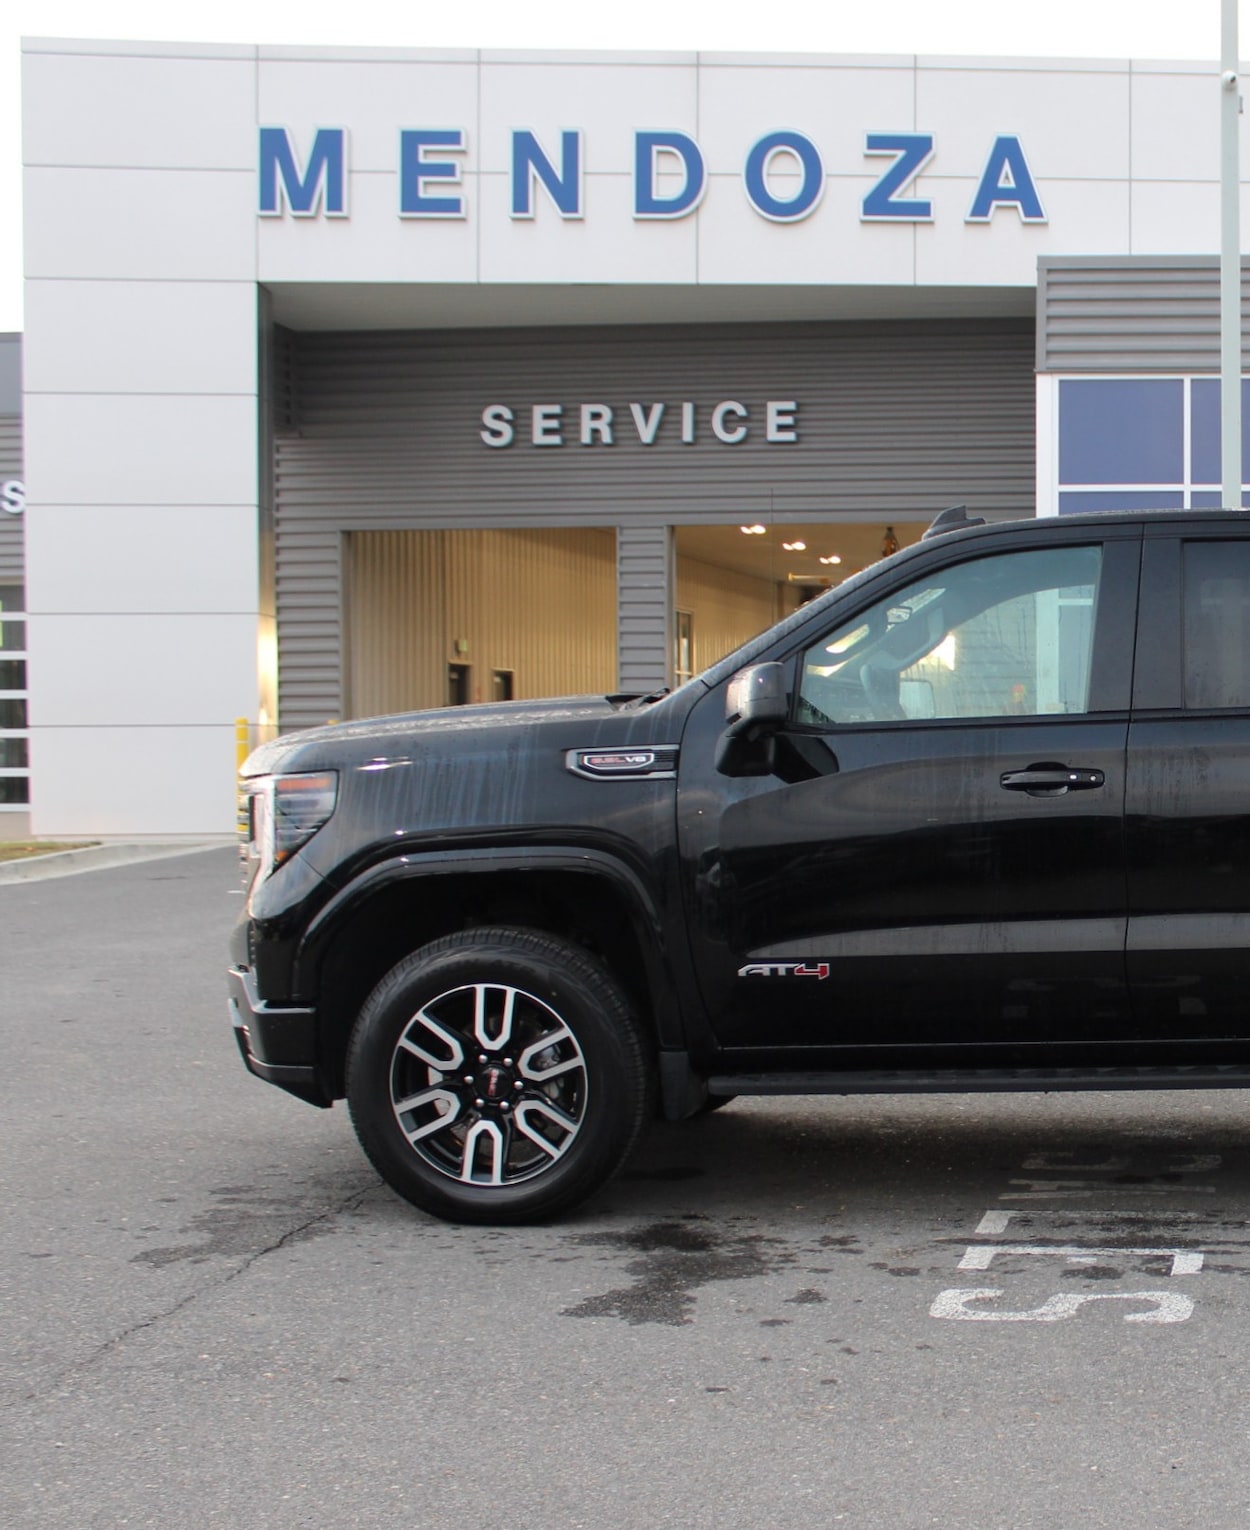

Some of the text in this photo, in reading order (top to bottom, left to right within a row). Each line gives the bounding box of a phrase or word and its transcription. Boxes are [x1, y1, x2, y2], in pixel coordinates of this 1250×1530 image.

[256, 126, 1049, 224] MENDOZA
[480, 400, 798, 447] SERVICE
[738, 963, 830, 980] AT4
